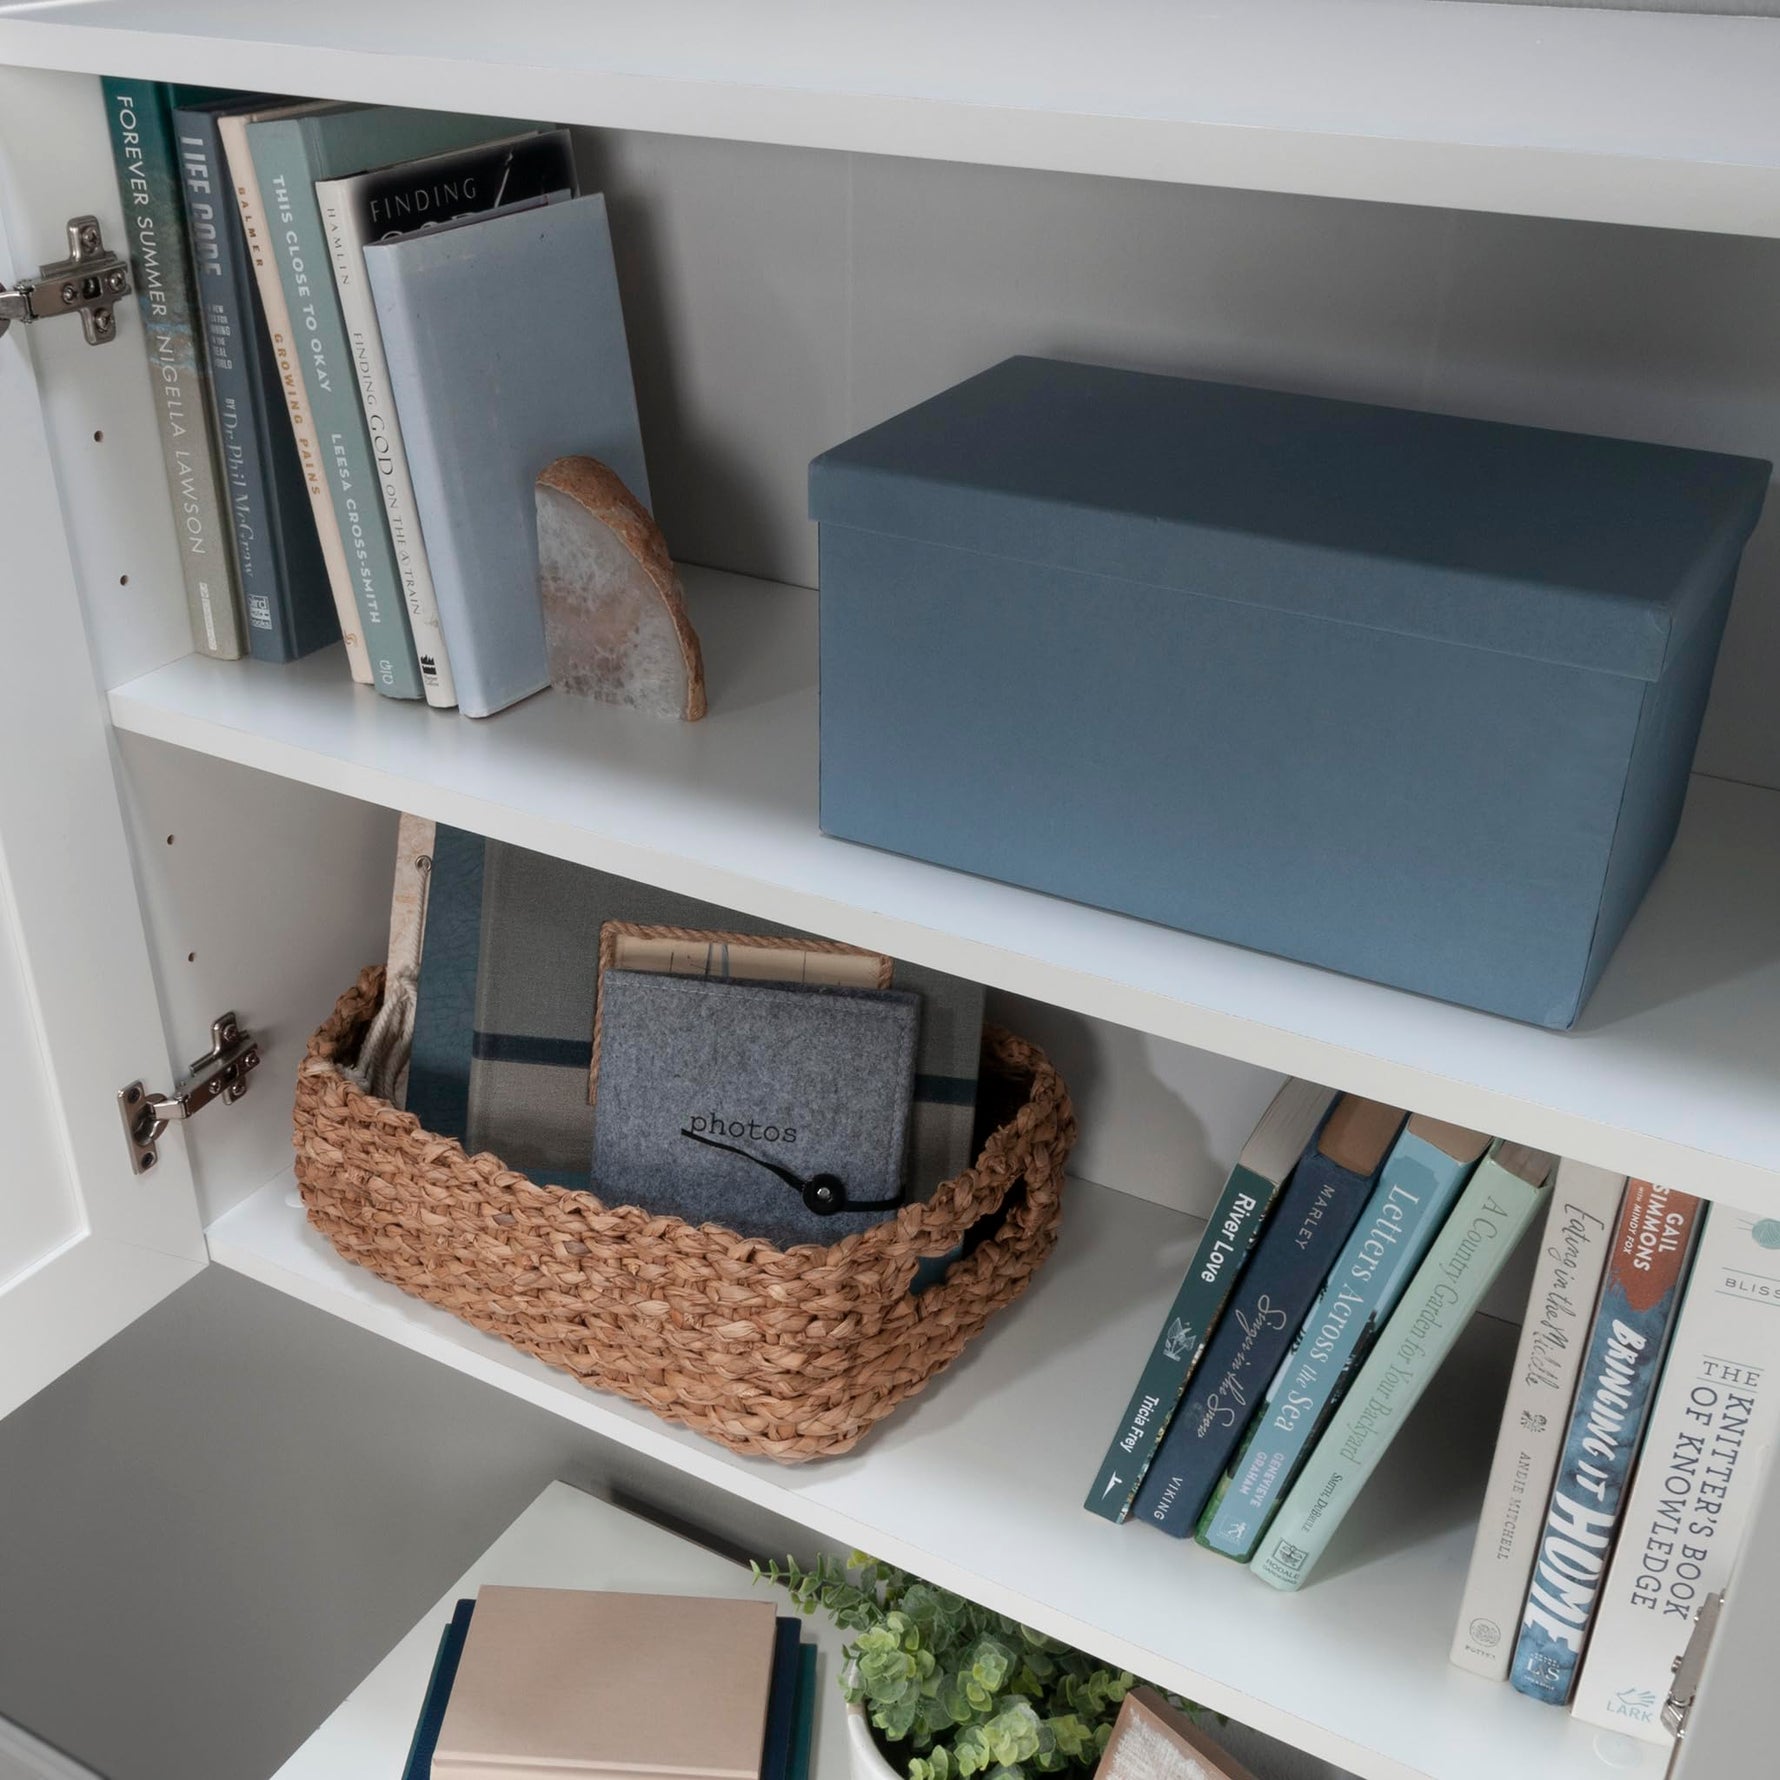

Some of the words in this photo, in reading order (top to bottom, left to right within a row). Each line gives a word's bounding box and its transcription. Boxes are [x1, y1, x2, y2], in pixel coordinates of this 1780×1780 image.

[116, 95, 149, 206] FOREVER
[137, 216, 167, 316] SUMMER
[370, 177, 477, 223] FINDING
[238, 187, 264, 267] BALMER
[327, 208, 350, 285] HAMLIN
[272, 174, 293, 223] THIS
[286, 231, 311, 297] CLOSE
[302, 304, 317, 331] TO
[311, 339, 332, 392] OKAY
[274, 333, 303, 425] GROWING
[300, 438, 321, 496] PAINS
[156, 334, 187, 438] NIGELLA
[175, 450, 206, 554] LAWSON
[227, 445, 247, 487] Phil
[353, 332, 376, 406] FINDING
[370, 414, 394, 476] GOD
[386, 484, 398, 509] ON
[392, 517, 406, 545] THE
[404, 570, 421, 615] TRAIN
[235, 494, 254, 578] McGraw
[331, 433, 351, 492] LEESA
[346, 499, 381, 624] CROSS-SMITH
[690, 1112, 797, 1143] photos
[1222, 1192, 1257, 1241] River
[1295, 1184, 1336, 1250] MARLEY
[1481, 1195, 1509, 1219] A
[1628, 1203, 1642, 1234] MINDY
[1633, 1183, 1670, 1271] SIMMONS
[1351, 1184, 1420, 1282] Letters
[1439, 1217, 1498, 1284] Country
[1548, 1203, 1605, 1268] Eating
[1623, 1235, 1635, 1255] FOX
[1657, 1212, 1684, 1252] GAIL
[1201, 1239, 1234, 1283] Love
[1553, 1268, 1575, 1289] in
[1236, 1294, 1287, 1350] Singer
[1310, 1283, 1365, 1363] Across
[1412, 1283, 1459, 1337] Garden
[1545, 1291, 1576, 1319] the
[1231, 1352, 1251, 1371] in
[1398, 1338, 1426, 1365] for
[1703, 1360, 1761, 1388] THE
[1219, 1371, 1246, 1406] the
[1296, 1364, 1318, 1389] the
[1377, 1363, 1414, 1398] Your
[1582, 1318, 1647, 1462] BRINGING
[1134, 1395, 1160, 1426] Tricia
[1197, 1393, 1235, 1439] Snow
[1274, 1390, 1314, 1432] Sea
[1686, 1386, 1718, 1426] OF
[1119, 1426, 1145, 1453] Frey
[1339, 1398, 1393, 1465] Backyard
[1239, 1450, 1268, 1496] GRAHAM
[1250, 1451, 1285, 1509] GENEVIEVE
[1512, 1451, 1532, 1495] ANDIE
[1575, 1459, 1609, 1503] IT
[1689, 1393, 1755, 1537] KNITTER'S
[1153, 1476, 1184, 1520] VIKING
[1630, 1432, 1705, 1610] KNOWLEDGE
[1497, 1498, 1523, 1560] MITCHELL
[1524, 1490, 1617, 1654] HOME
[1663, 1543, 1707, 1620] BOOK
[1606, 1700, 1655, 1723] LARK
